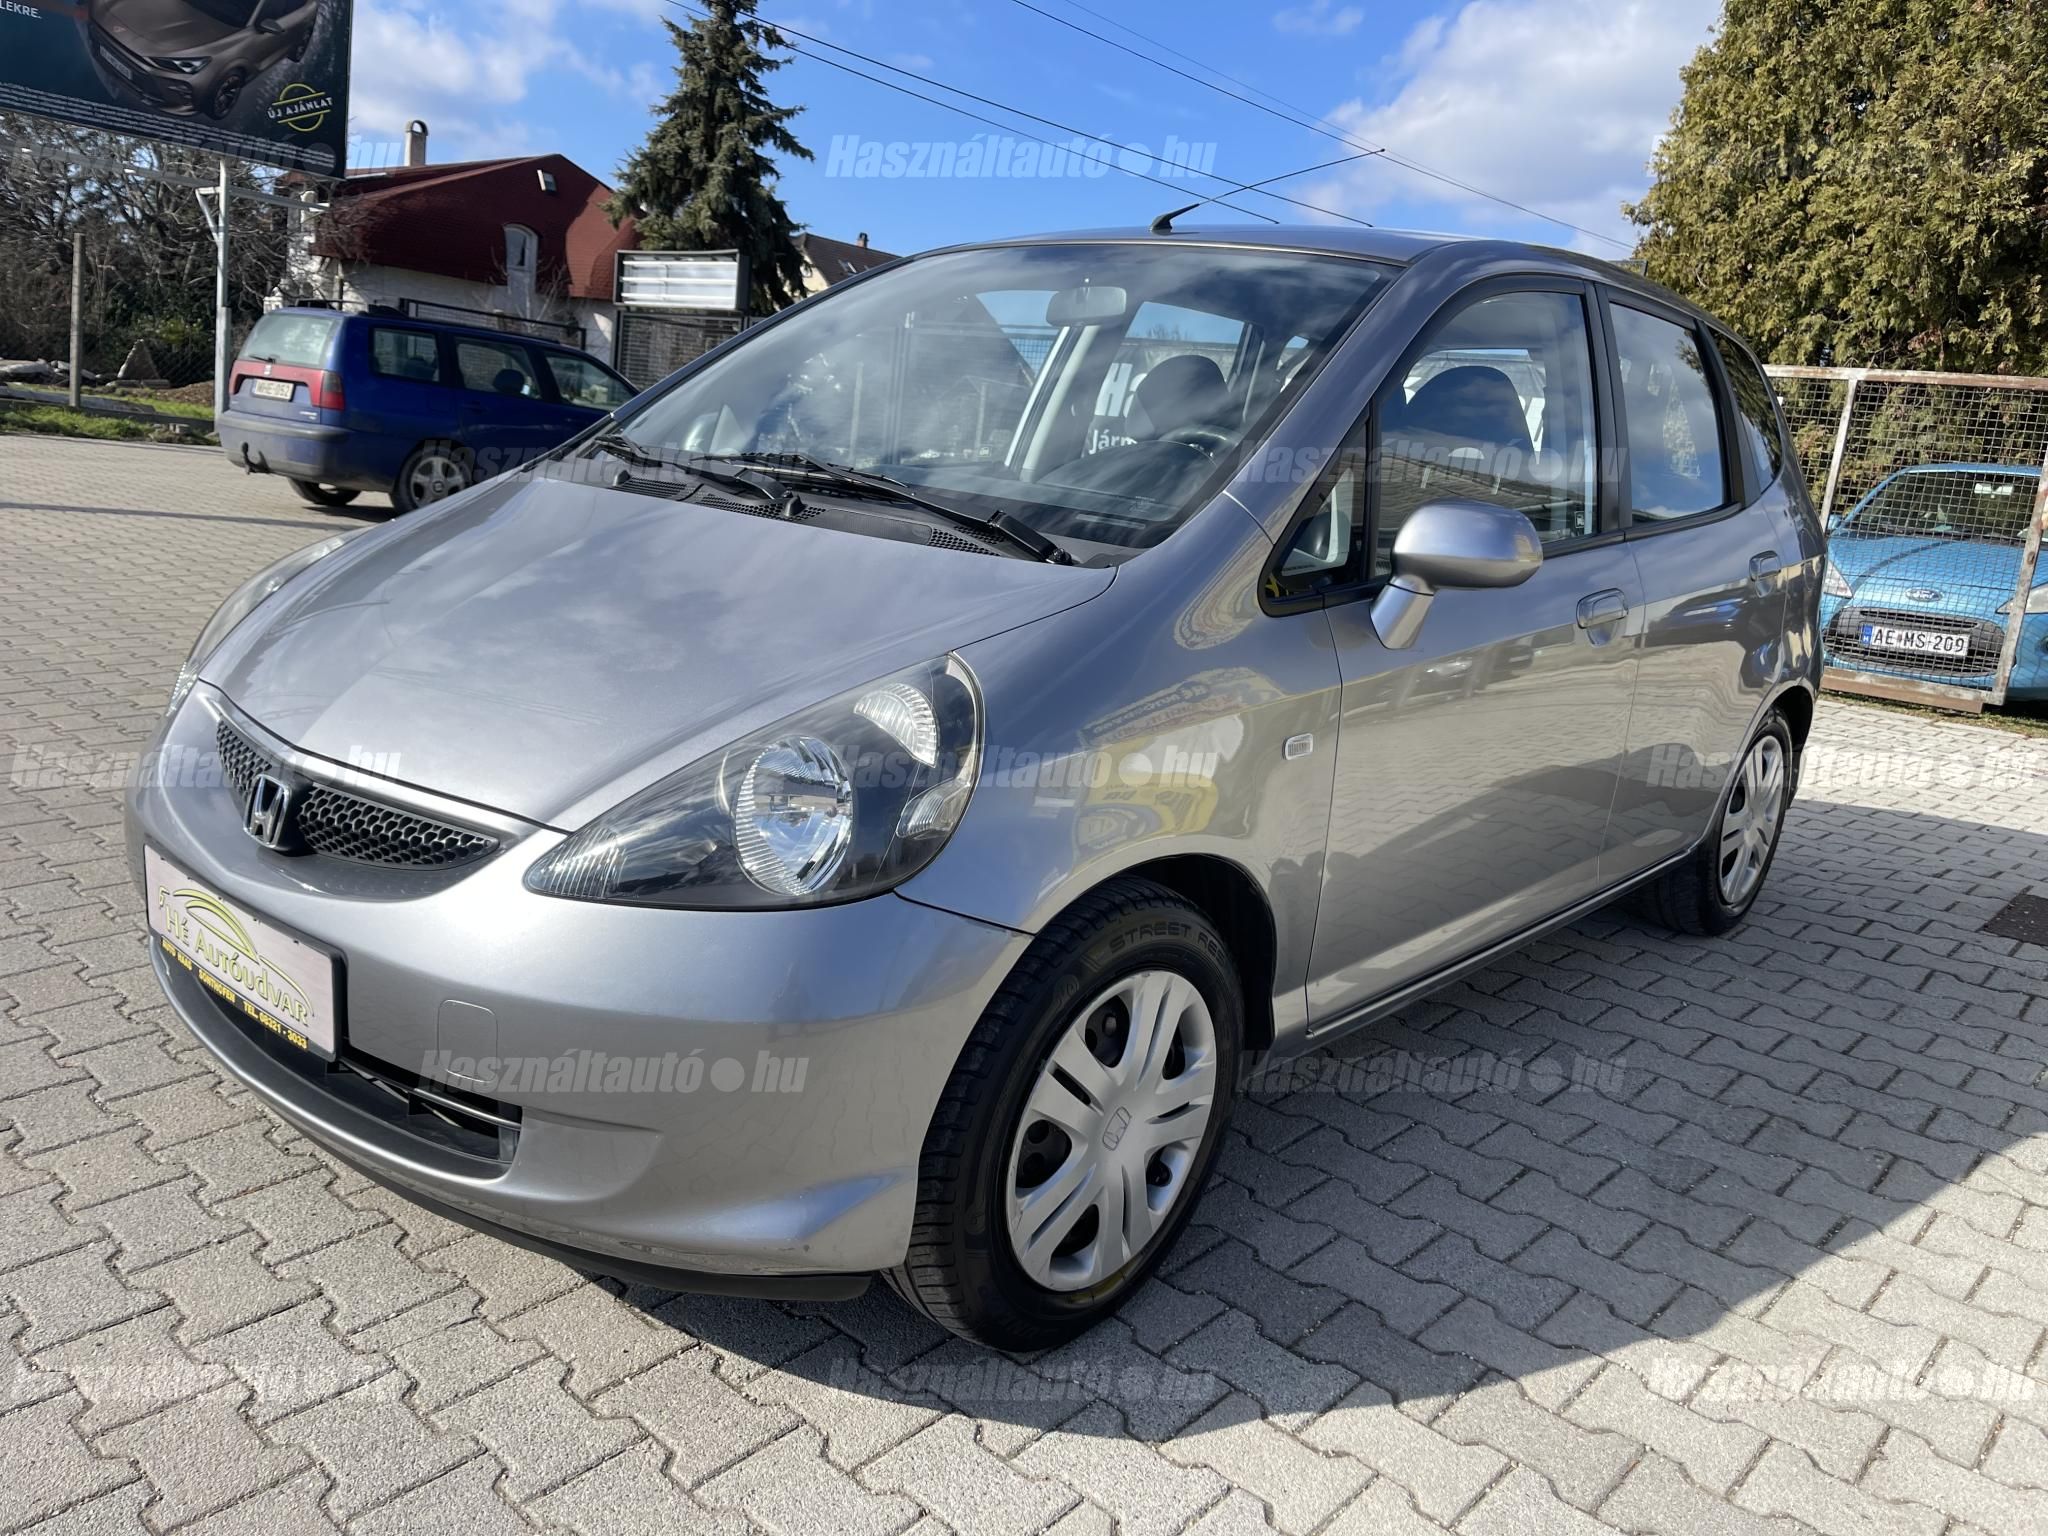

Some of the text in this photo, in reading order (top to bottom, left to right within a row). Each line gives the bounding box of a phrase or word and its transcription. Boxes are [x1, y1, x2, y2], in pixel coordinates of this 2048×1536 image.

[267, 97, 333, 119] ÚJ AJÁNLAT
[1873, 629, 1965, 653] AE MS-209
[1110, 921, 1192, 953] STREET
[243, 1000, 259, 1019] TEL.
